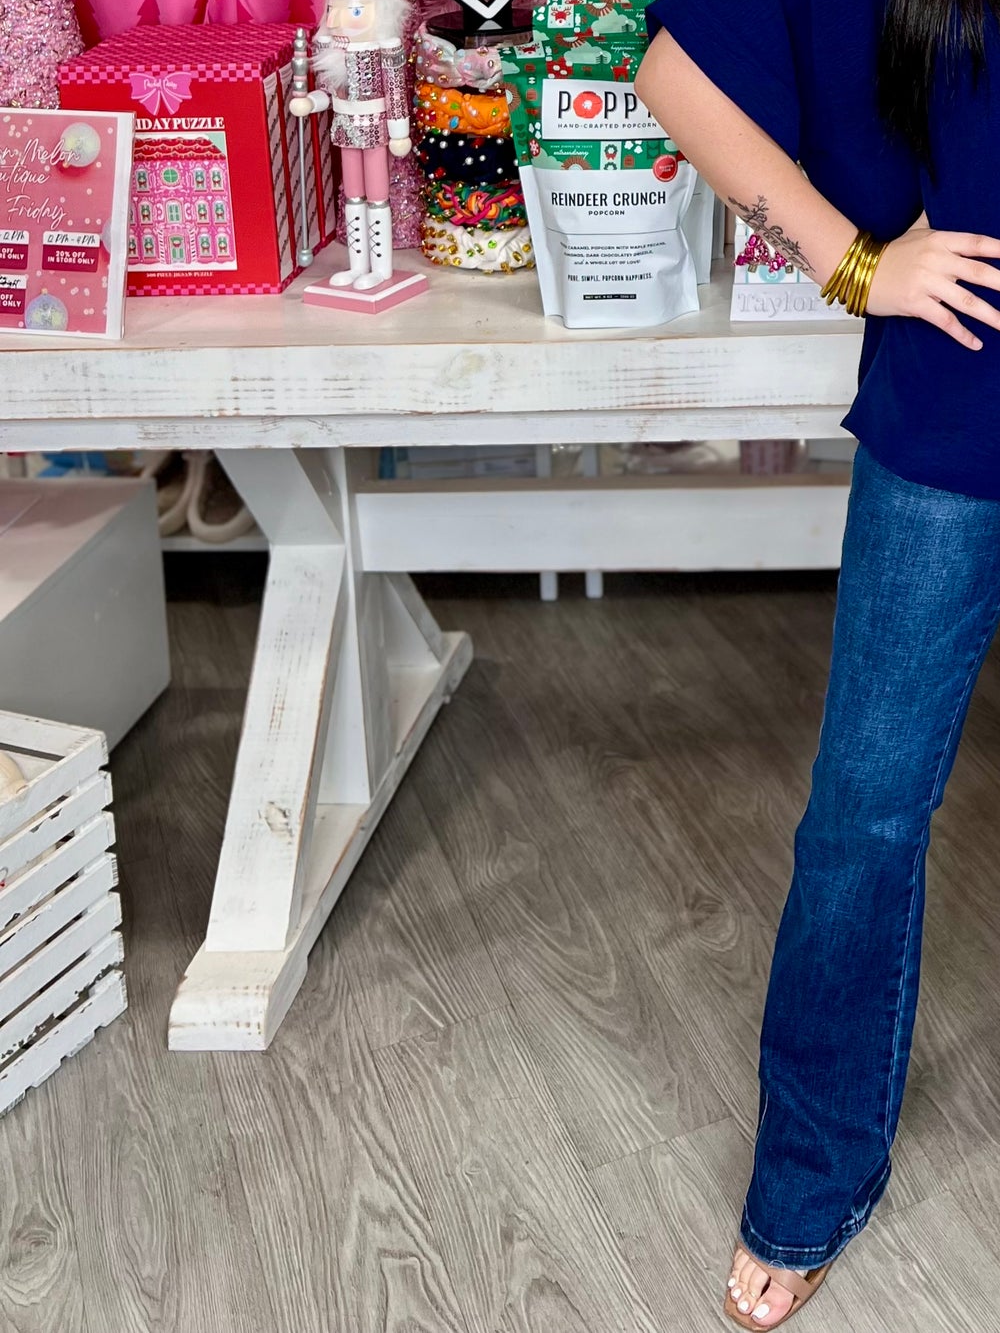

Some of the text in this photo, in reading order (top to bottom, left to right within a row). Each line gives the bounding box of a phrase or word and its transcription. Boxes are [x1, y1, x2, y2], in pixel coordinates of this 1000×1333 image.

[558, 90, 652, 120] POPP
[136, 116, 225, 130] IDAY PUZZLE
[20, 138, 80, 166] Melon
[0, 161, 50, 193] utique
[6, 195, 68, 230] Friday
[551, 191, 666, 207] REINDEER CRUNCH
[602, 274, 624, 282] POPCORN
[2, 300, 22, 308] ONLY
[738, 291, 821, 318] Taylor
